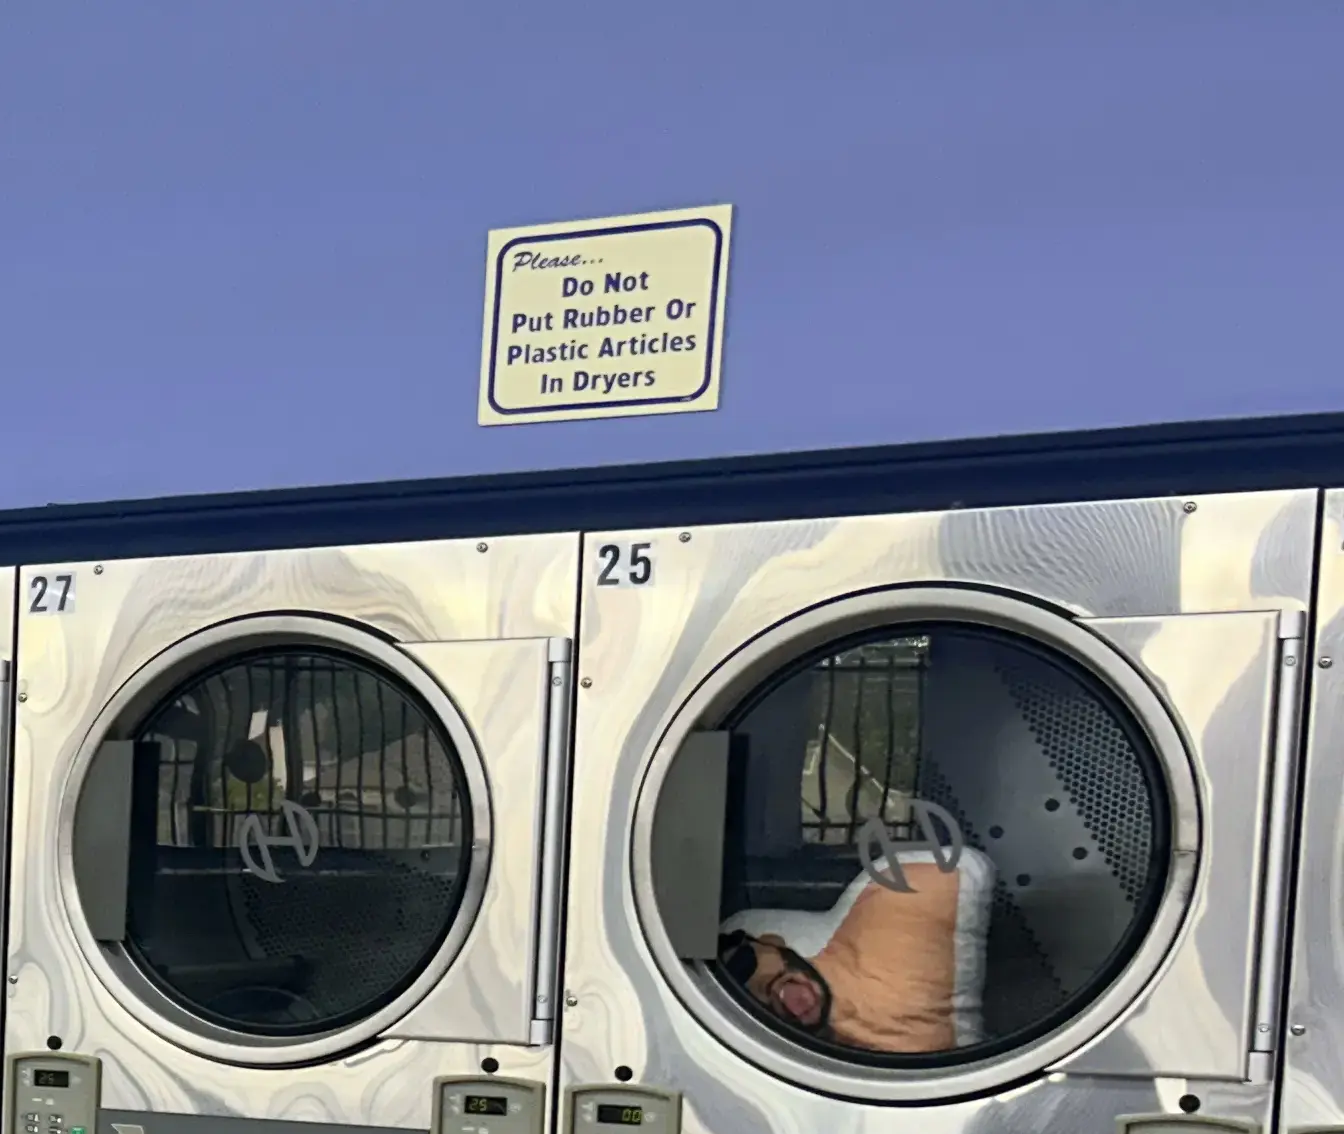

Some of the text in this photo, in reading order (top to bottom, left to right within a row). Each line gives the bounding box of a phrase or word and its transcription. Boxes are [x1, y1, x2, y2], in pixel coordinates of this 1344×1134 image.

[511, 250, 604, 272] Please...
[562, 271, 650, 298] Do Not
[511, 298, 696, 334] Put Rubber Or
[507, 332, 697, 366] Plastic Articles
[540, 369, 656, 394] In Dryers
[597, 542, 652, 587] 25
[30, 574, 73, 613] 27
